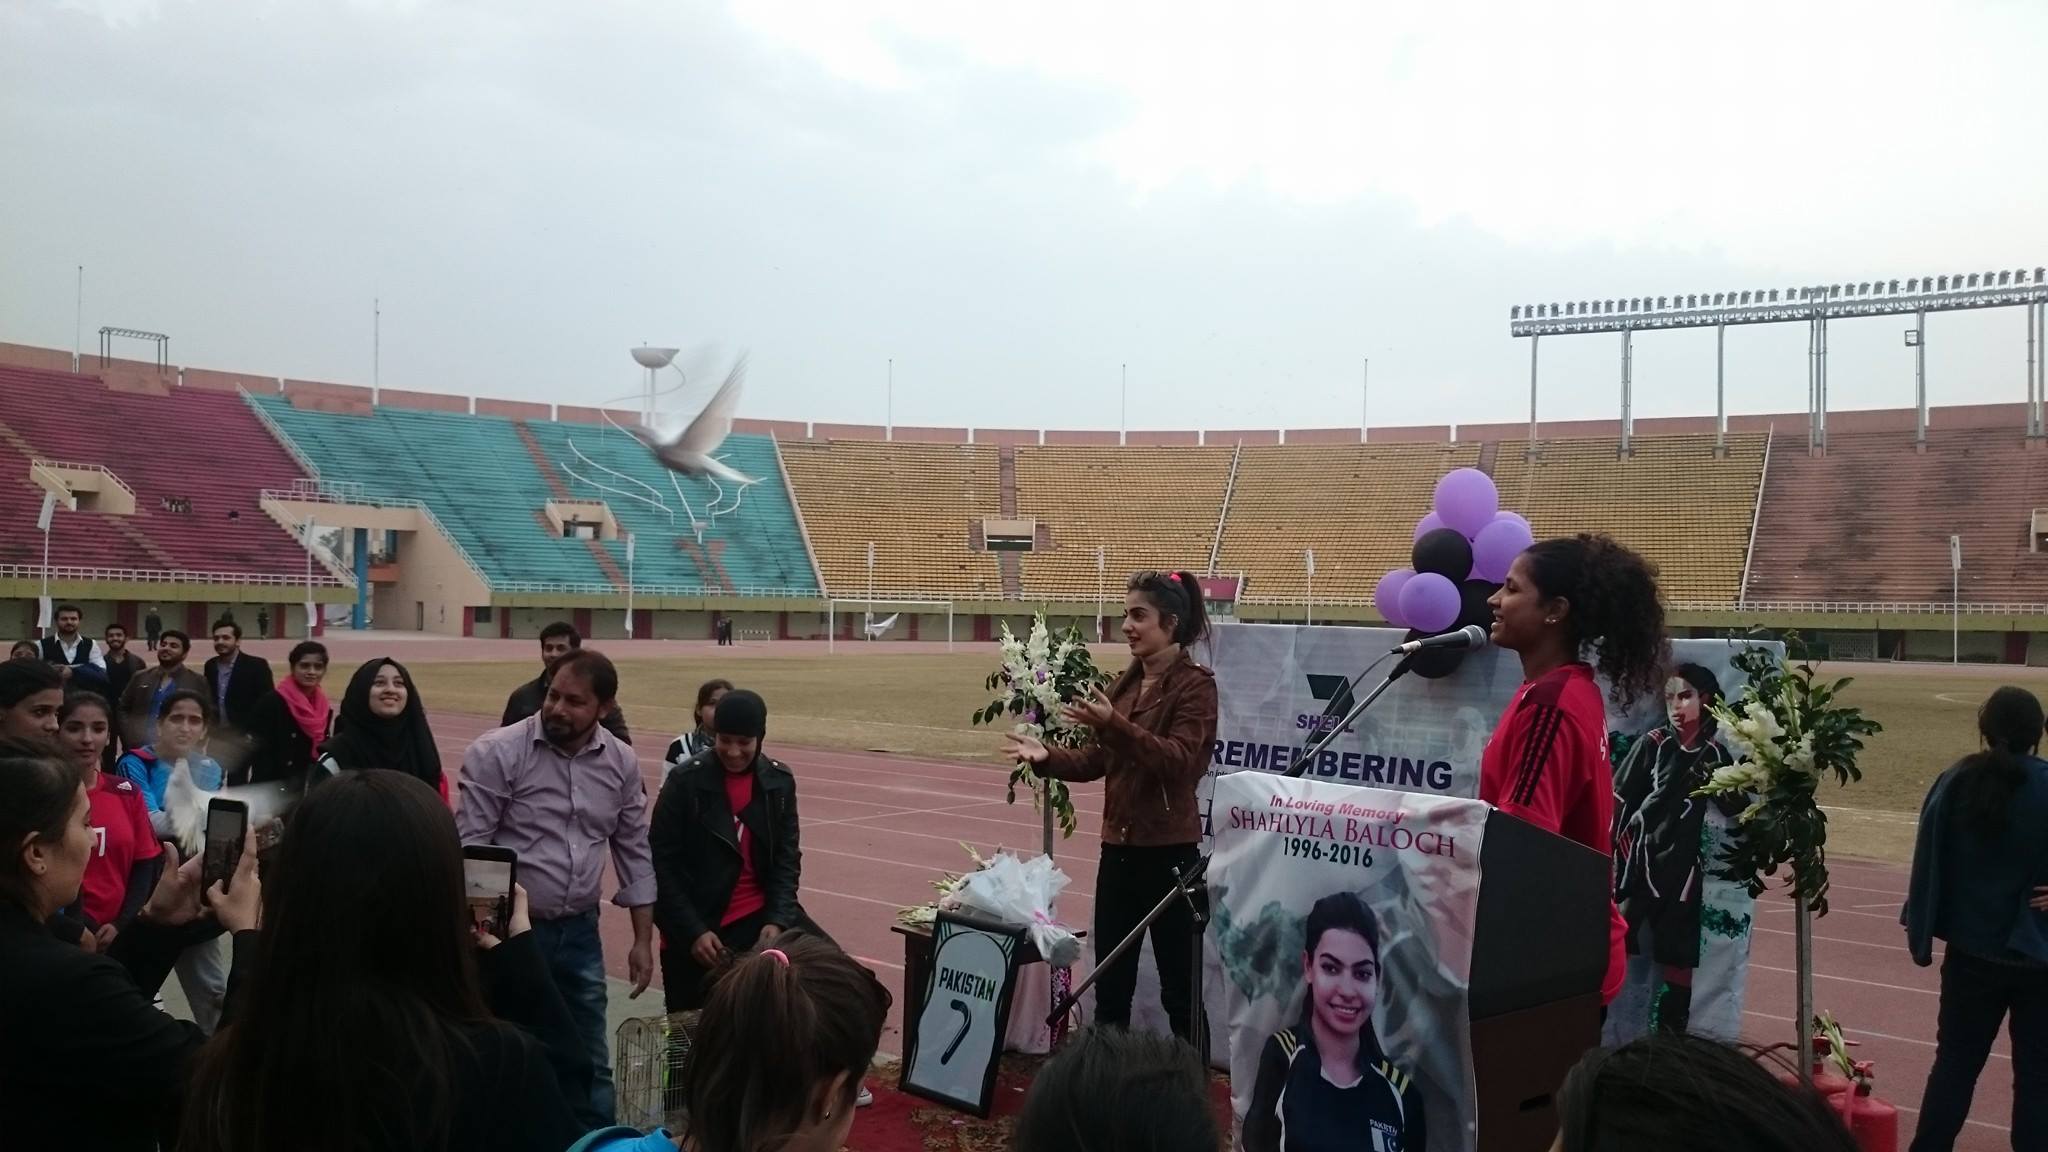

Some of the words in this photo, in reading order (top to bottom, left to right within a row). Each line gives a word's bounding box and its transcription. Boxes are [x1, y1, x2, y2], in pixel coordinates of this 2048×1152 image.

[1270, 795, 1283, 808] In
[1286, 797, 1335, 816] Loving
[1339, 803, 1405, 825] Memory
[1284, 837, 1373, 868] 1996-2016
[1344, 818, 1456, 858] BALOCH
[939, 966, 996, 1002] PAKISTAN
[941, 999, 971, 1066] 7
